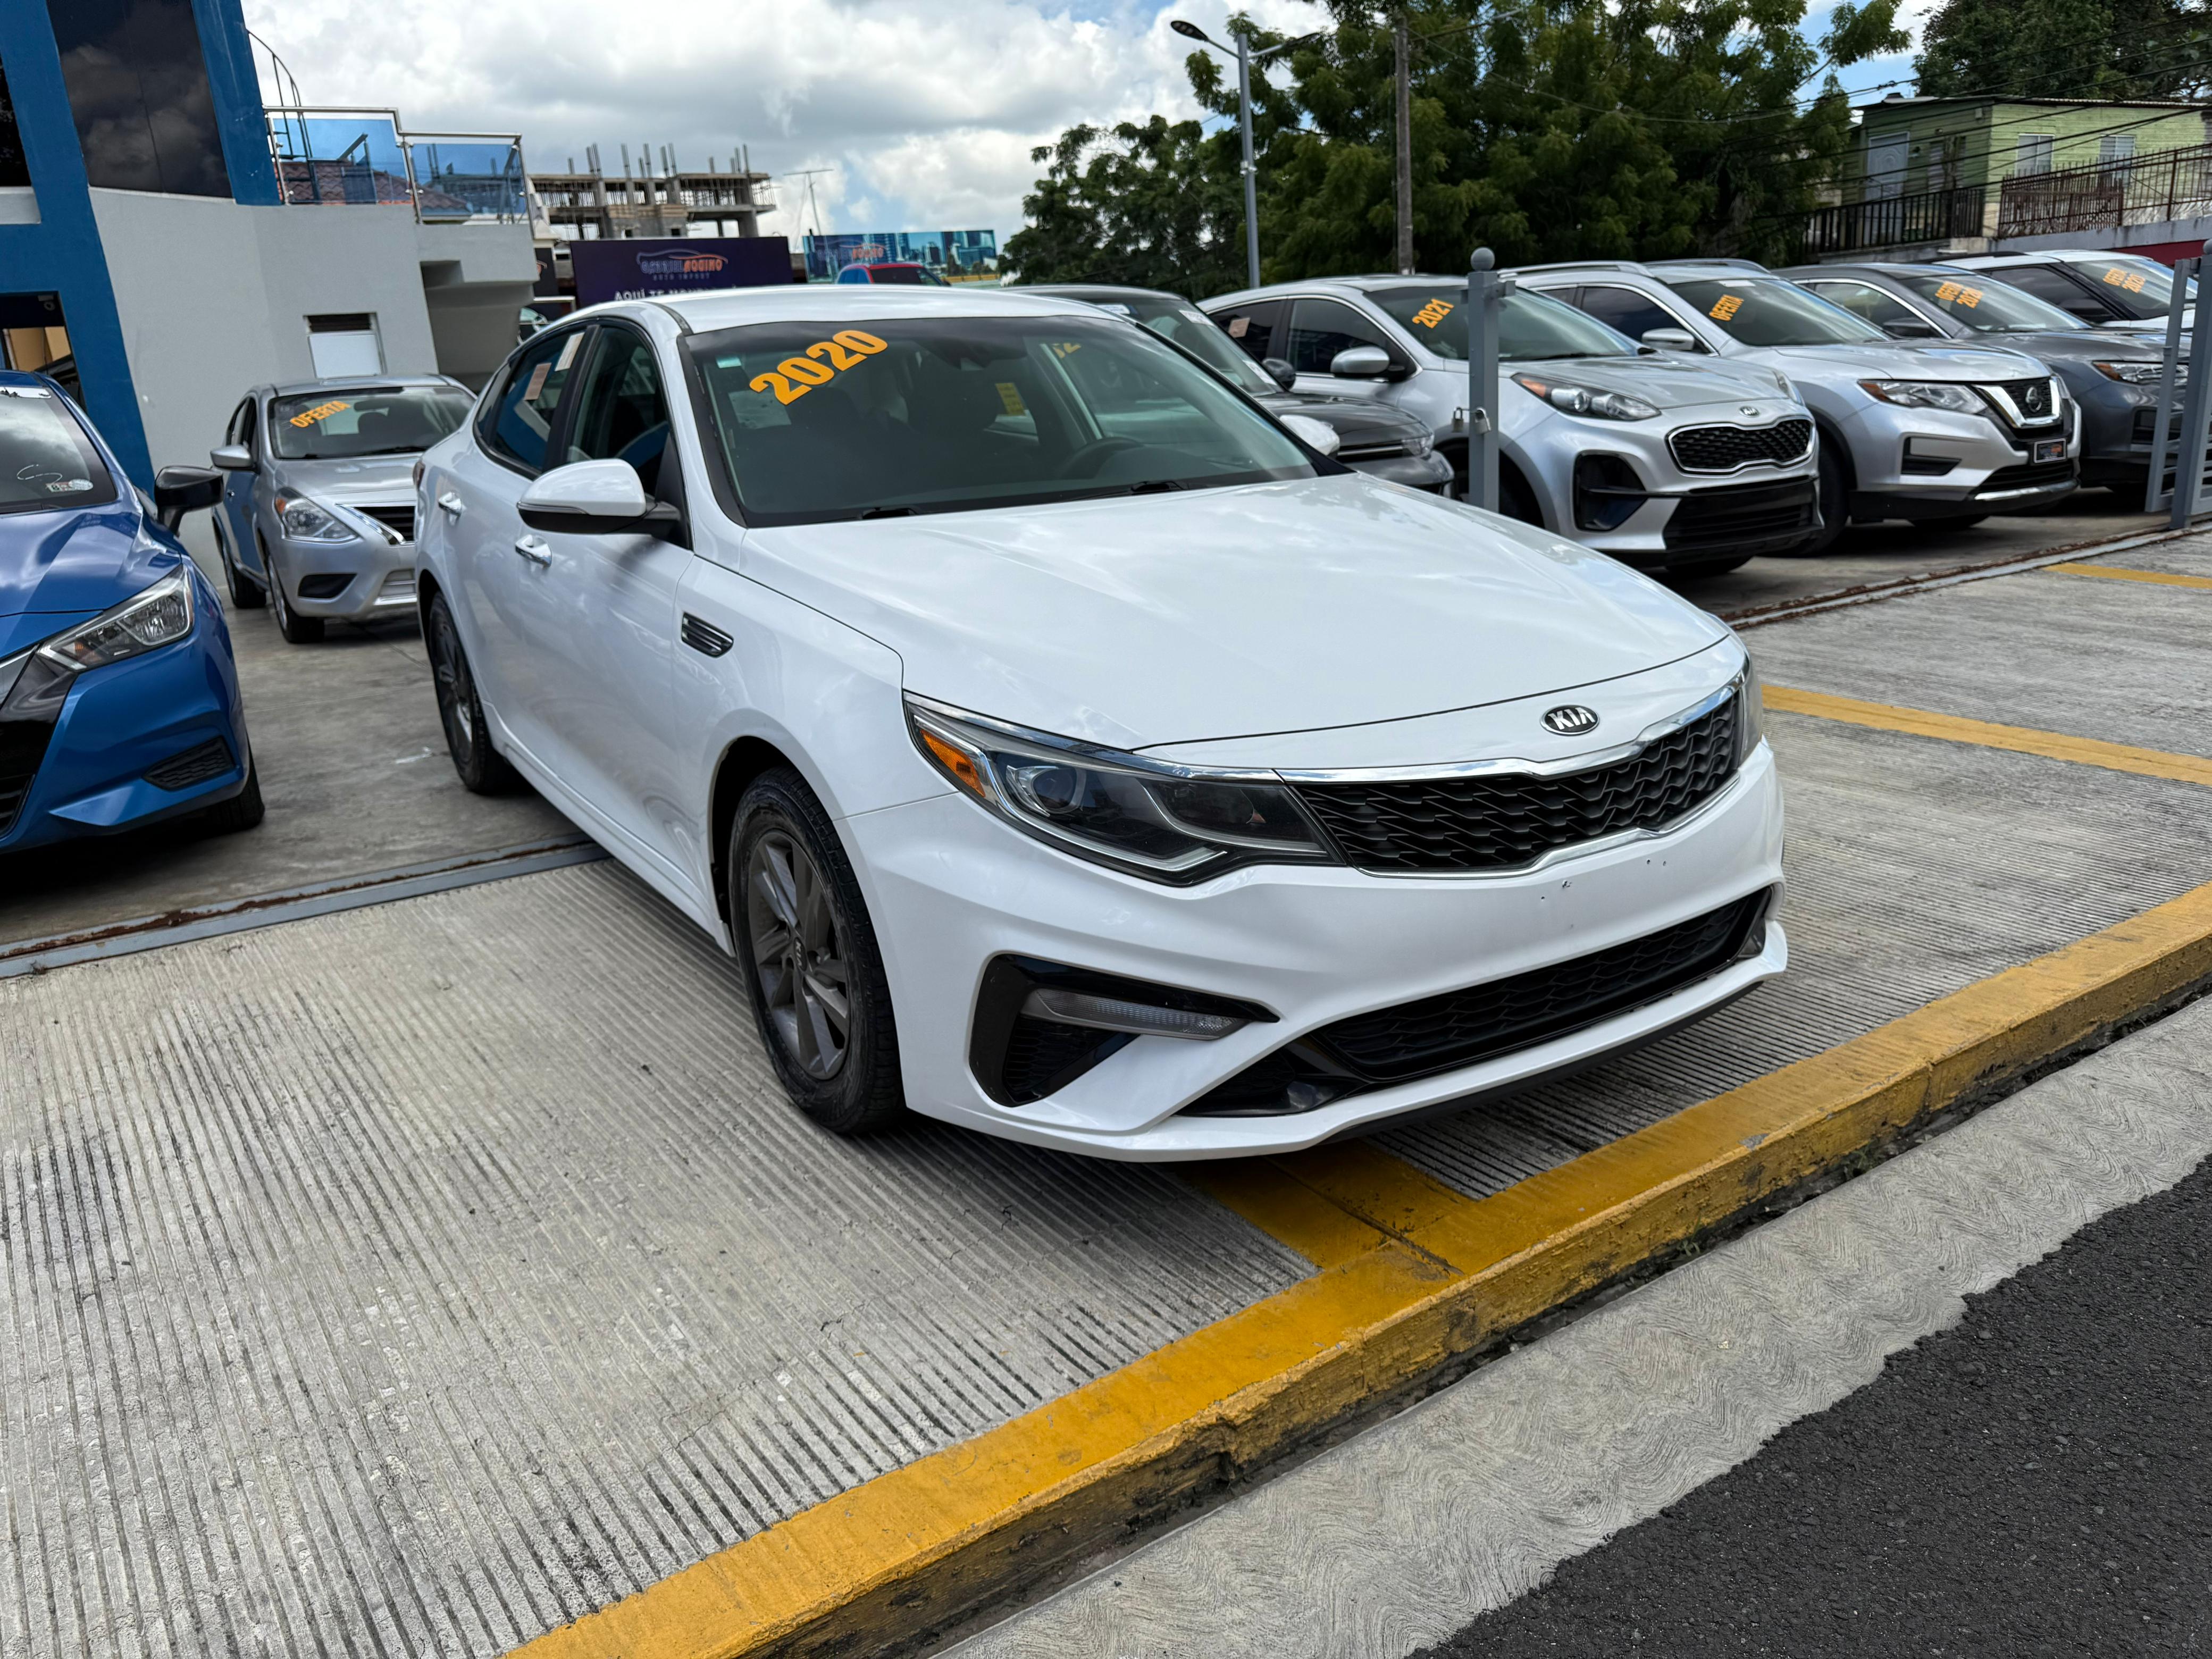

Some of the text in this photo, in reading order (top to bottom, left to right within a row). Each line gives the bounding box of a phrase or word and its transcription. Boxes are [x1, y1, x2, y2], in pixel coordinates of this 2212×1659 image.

[1411, 298, 1455, 329] 2021
[1708, 294, 1745, 322] OFERTA
[749, 330, 888, 406] 2020
[289, 400, 351, 428] OFERTA
[1547, 707, 1596, 730] KIA
